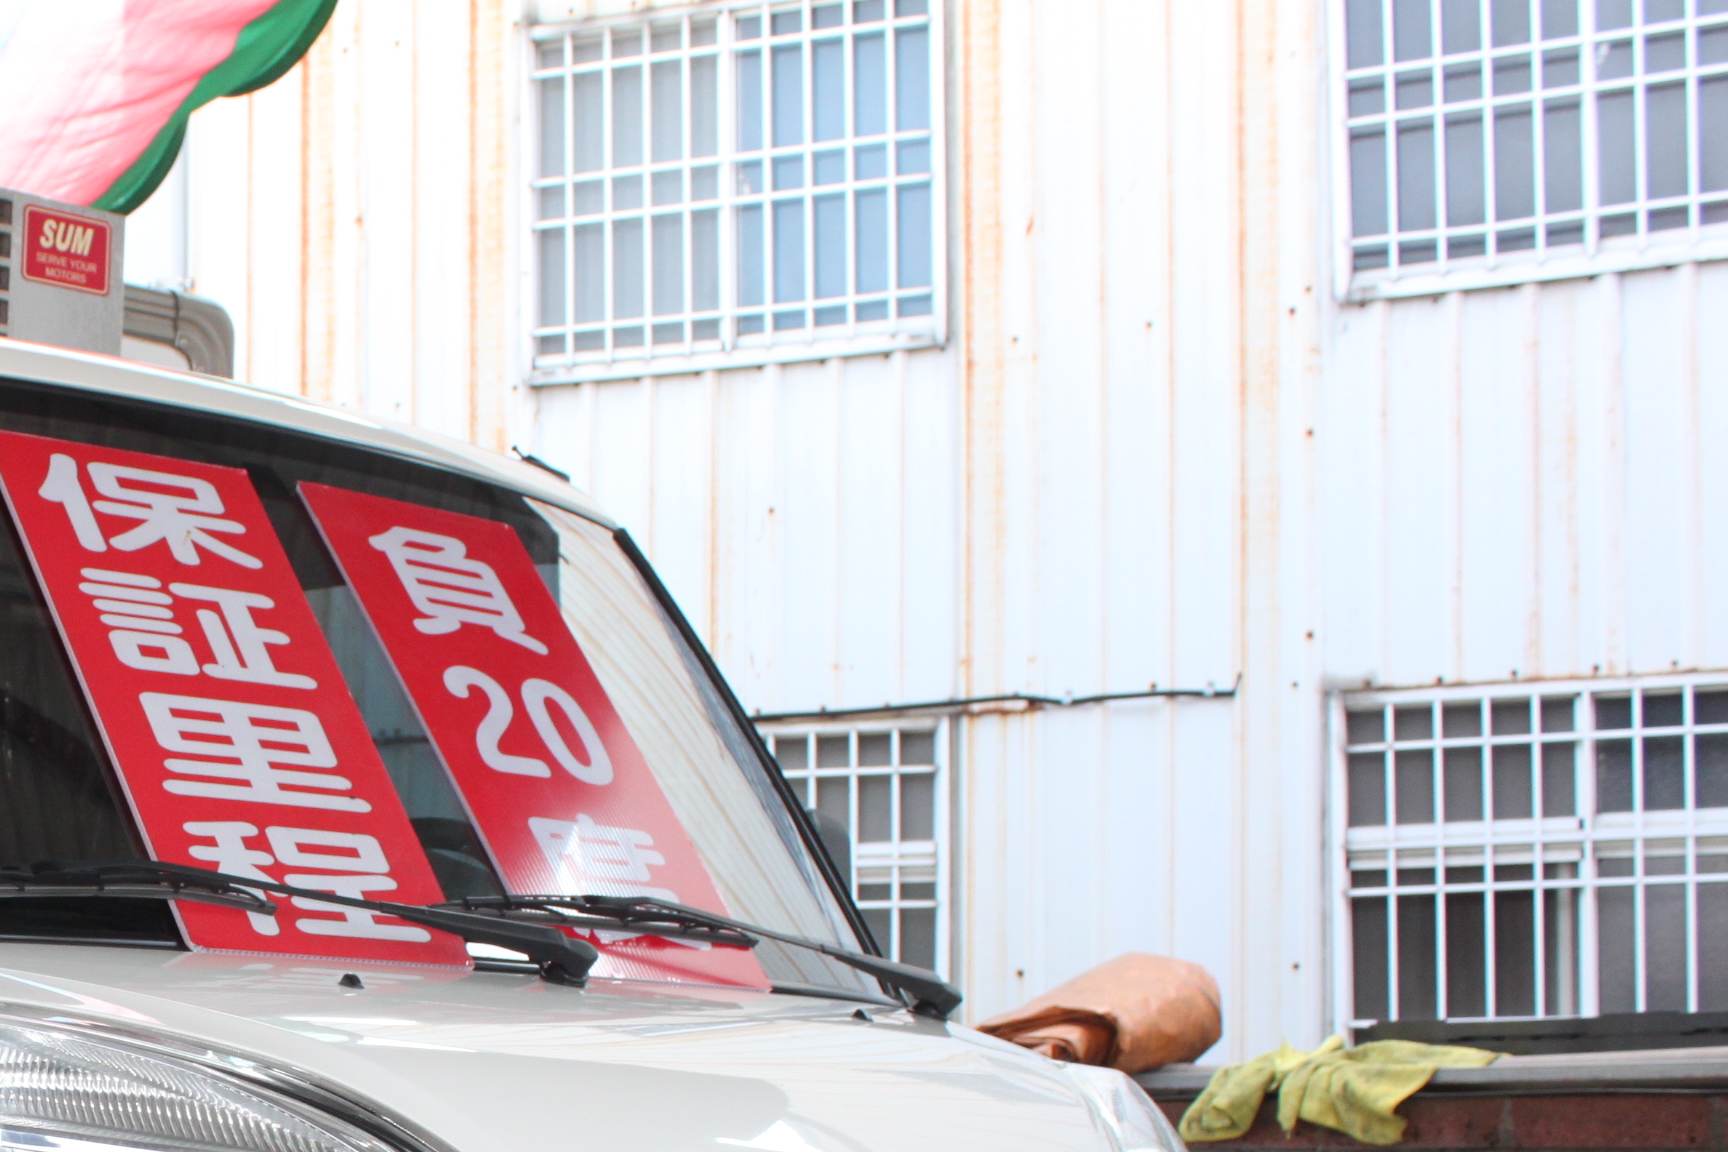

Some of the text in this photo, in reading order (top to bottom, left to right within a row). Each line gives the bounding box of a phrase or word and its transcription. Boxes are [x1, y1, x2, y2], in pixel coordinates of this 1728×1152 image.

[39, 218, 94, 257] SUM
[36, 252, 97, 274] SERVE YOUR
[45, 267, 87, 284] MOTORS
